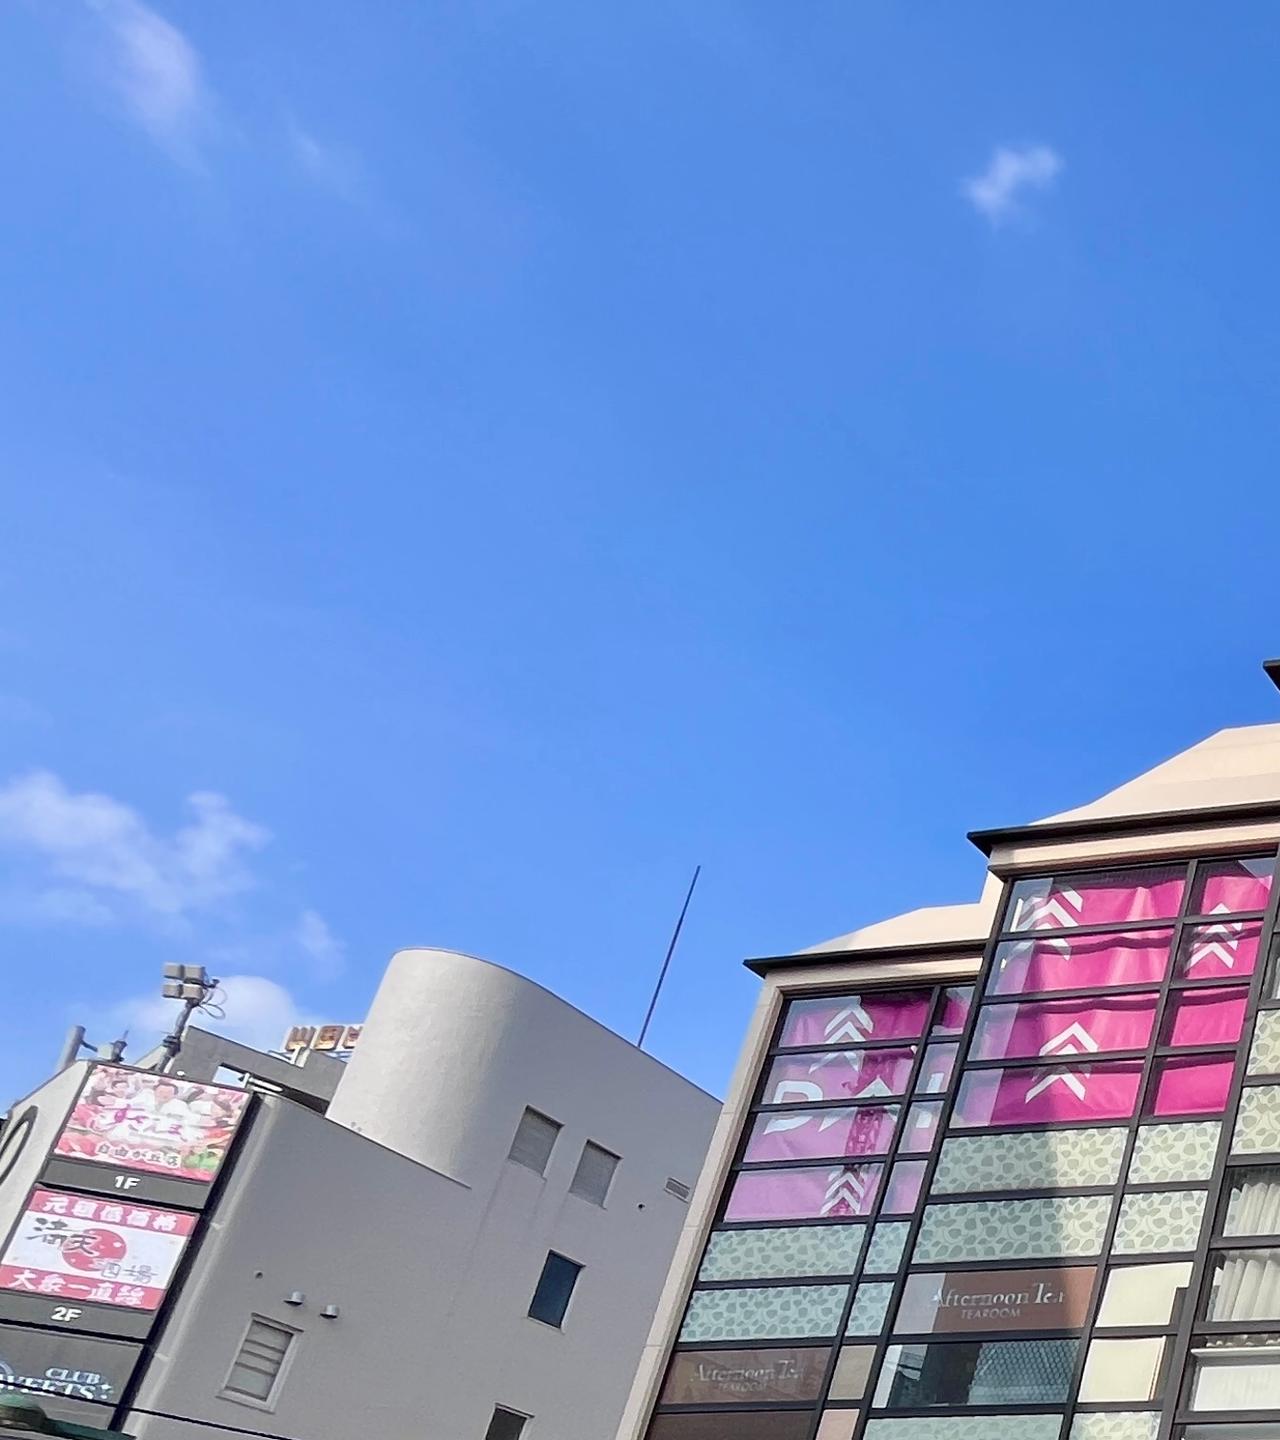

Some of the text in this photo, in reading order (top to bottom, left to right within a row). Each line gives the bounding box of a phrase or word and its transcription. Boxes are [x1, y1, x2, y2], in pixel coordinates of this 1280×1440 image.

[114, 1175, 141, 1190] 1F
[930, 1286, 1029, 1310] Afternoon
[51, 1307, 83, 1322] 2F
[961, 1307, 1021, 1321] TEAROOM
[44, 1367, 101, 1384] CLUB
